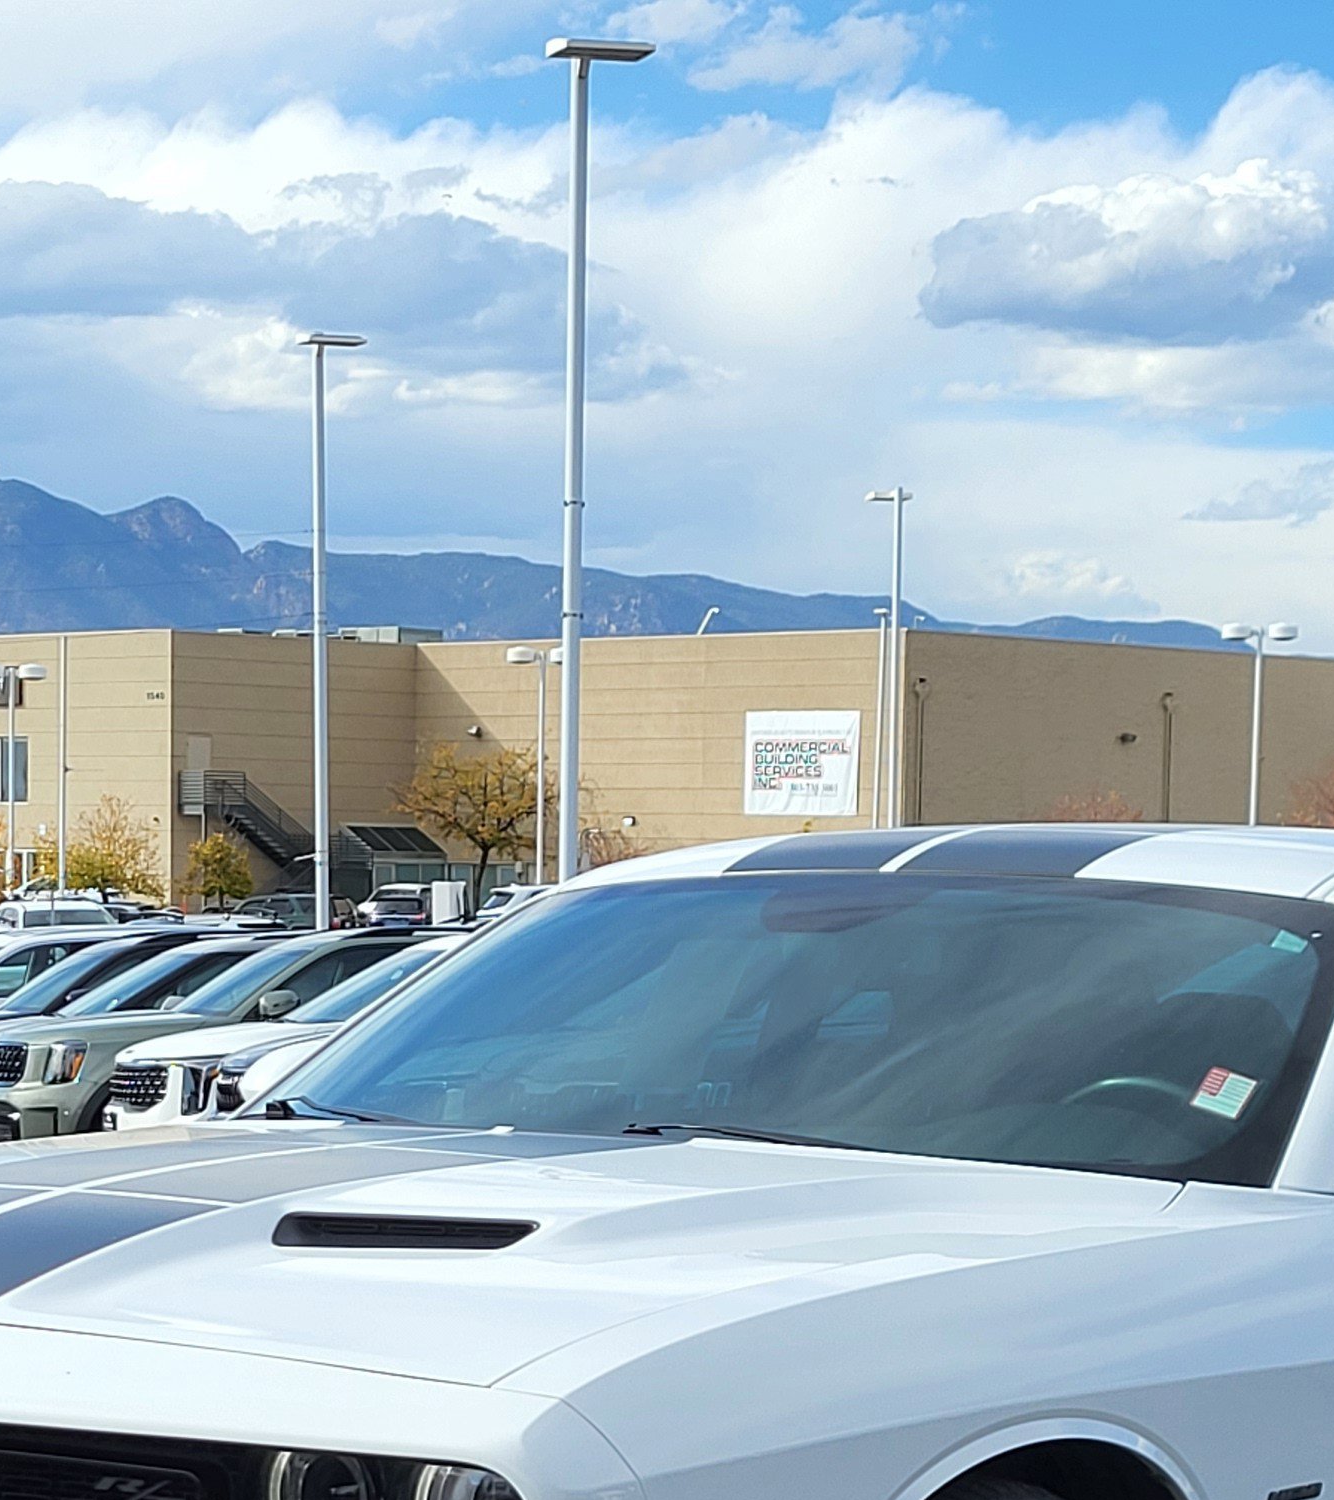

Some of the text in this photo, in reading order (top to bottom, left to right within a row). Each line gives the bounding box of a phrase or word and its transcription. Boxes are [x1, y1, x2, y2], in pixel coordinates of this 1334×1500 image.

[754, 742, 849, 754] COMMERCIAL
[754, 754, 818, 765] BUILDING
[754, 765, 823, 777] SERVICES
